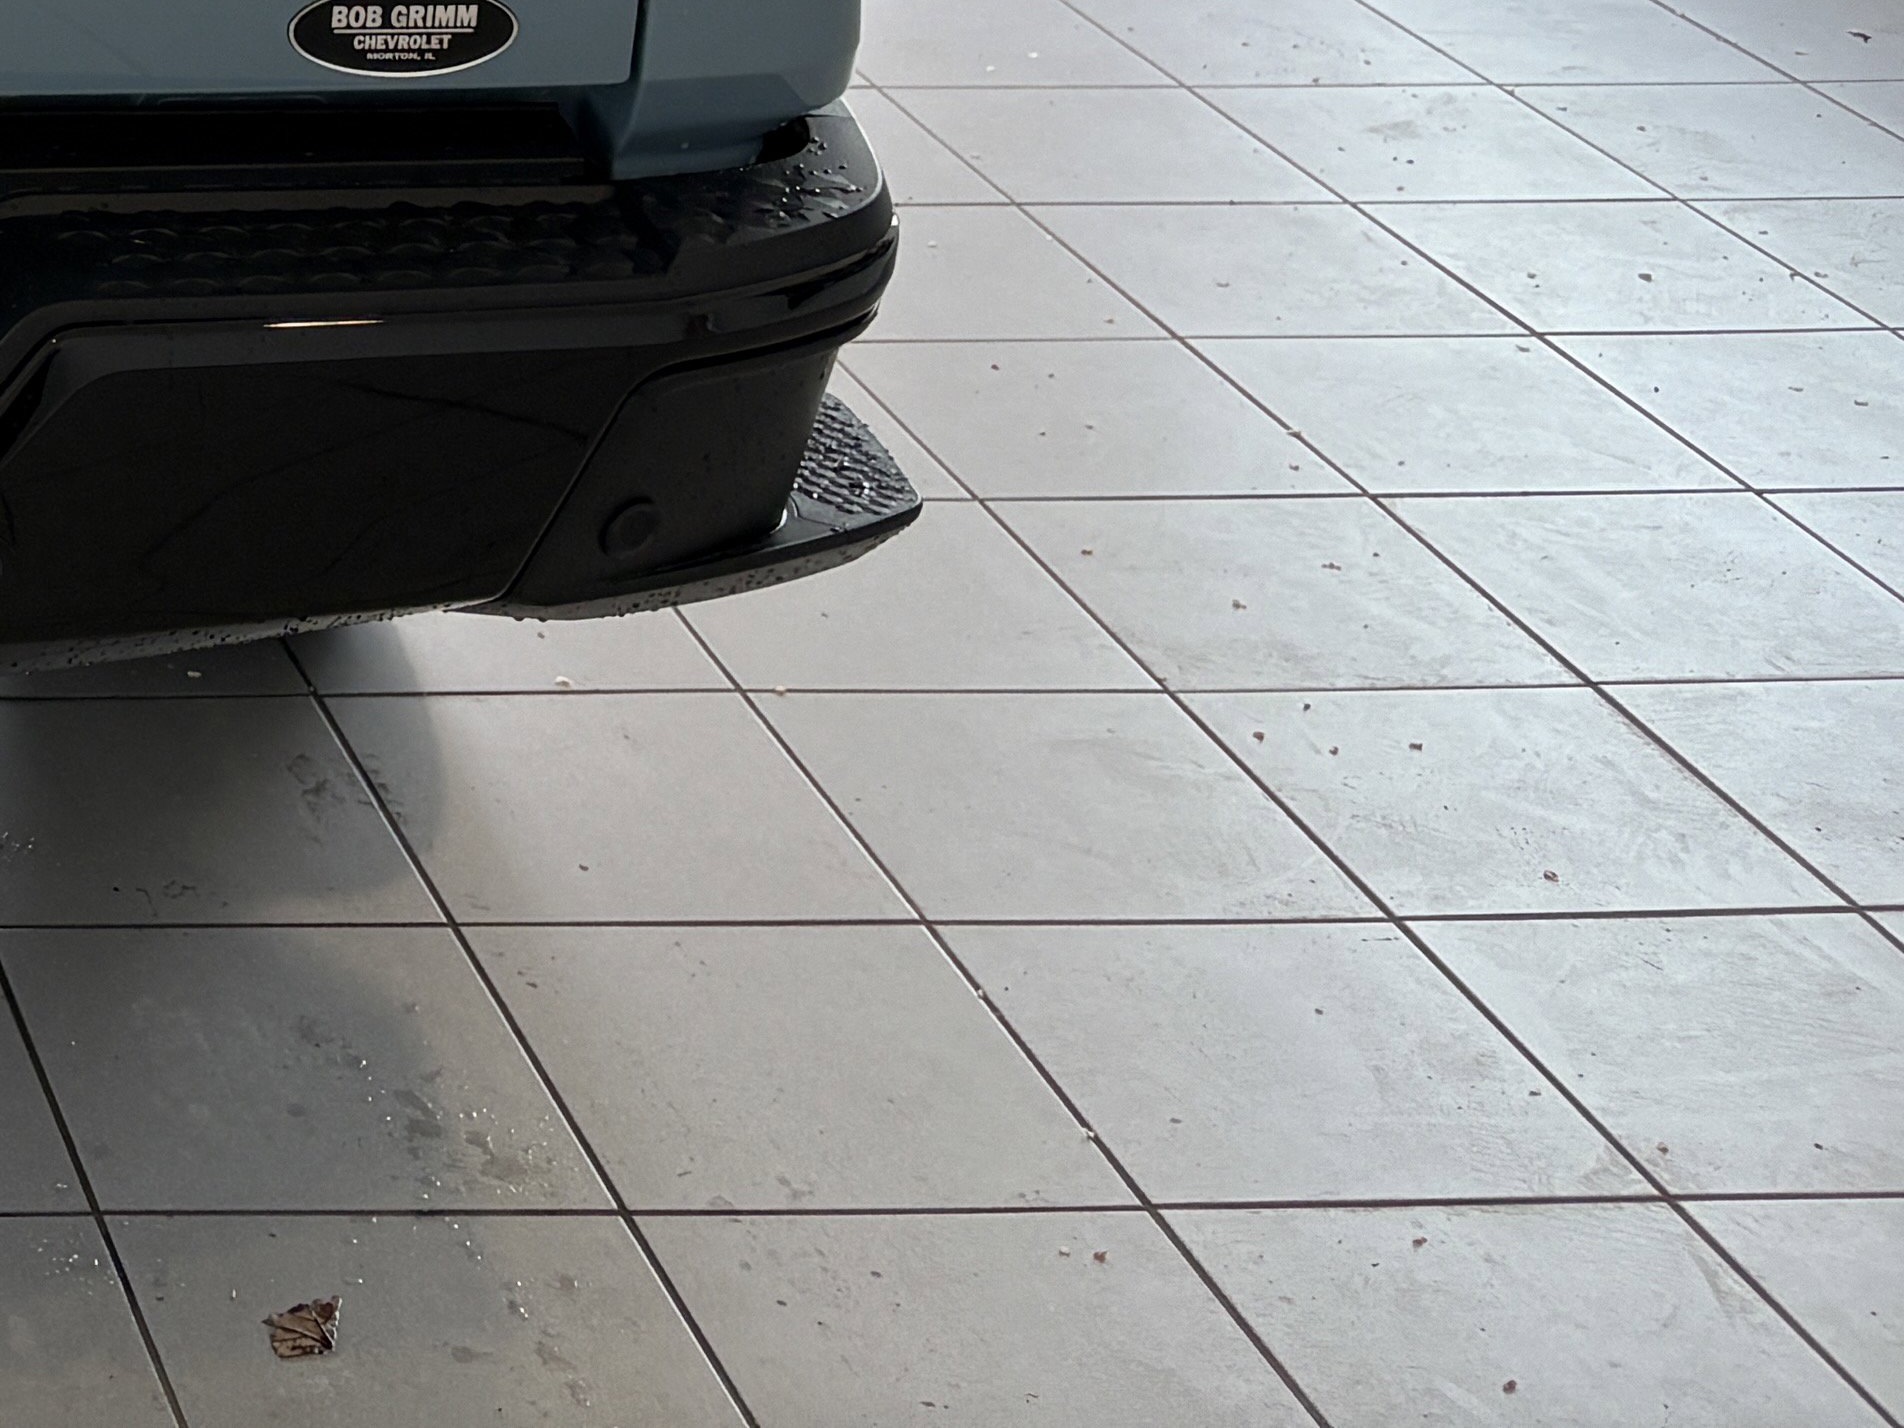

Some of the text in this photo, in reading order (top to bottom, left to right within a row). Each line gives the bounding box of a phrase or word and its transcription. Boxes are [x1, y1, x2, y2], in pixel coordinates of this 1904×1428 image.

[331, 4, 479, 29] BOB GRIMM
[353, 34, 453, 51] CHEVROLET
